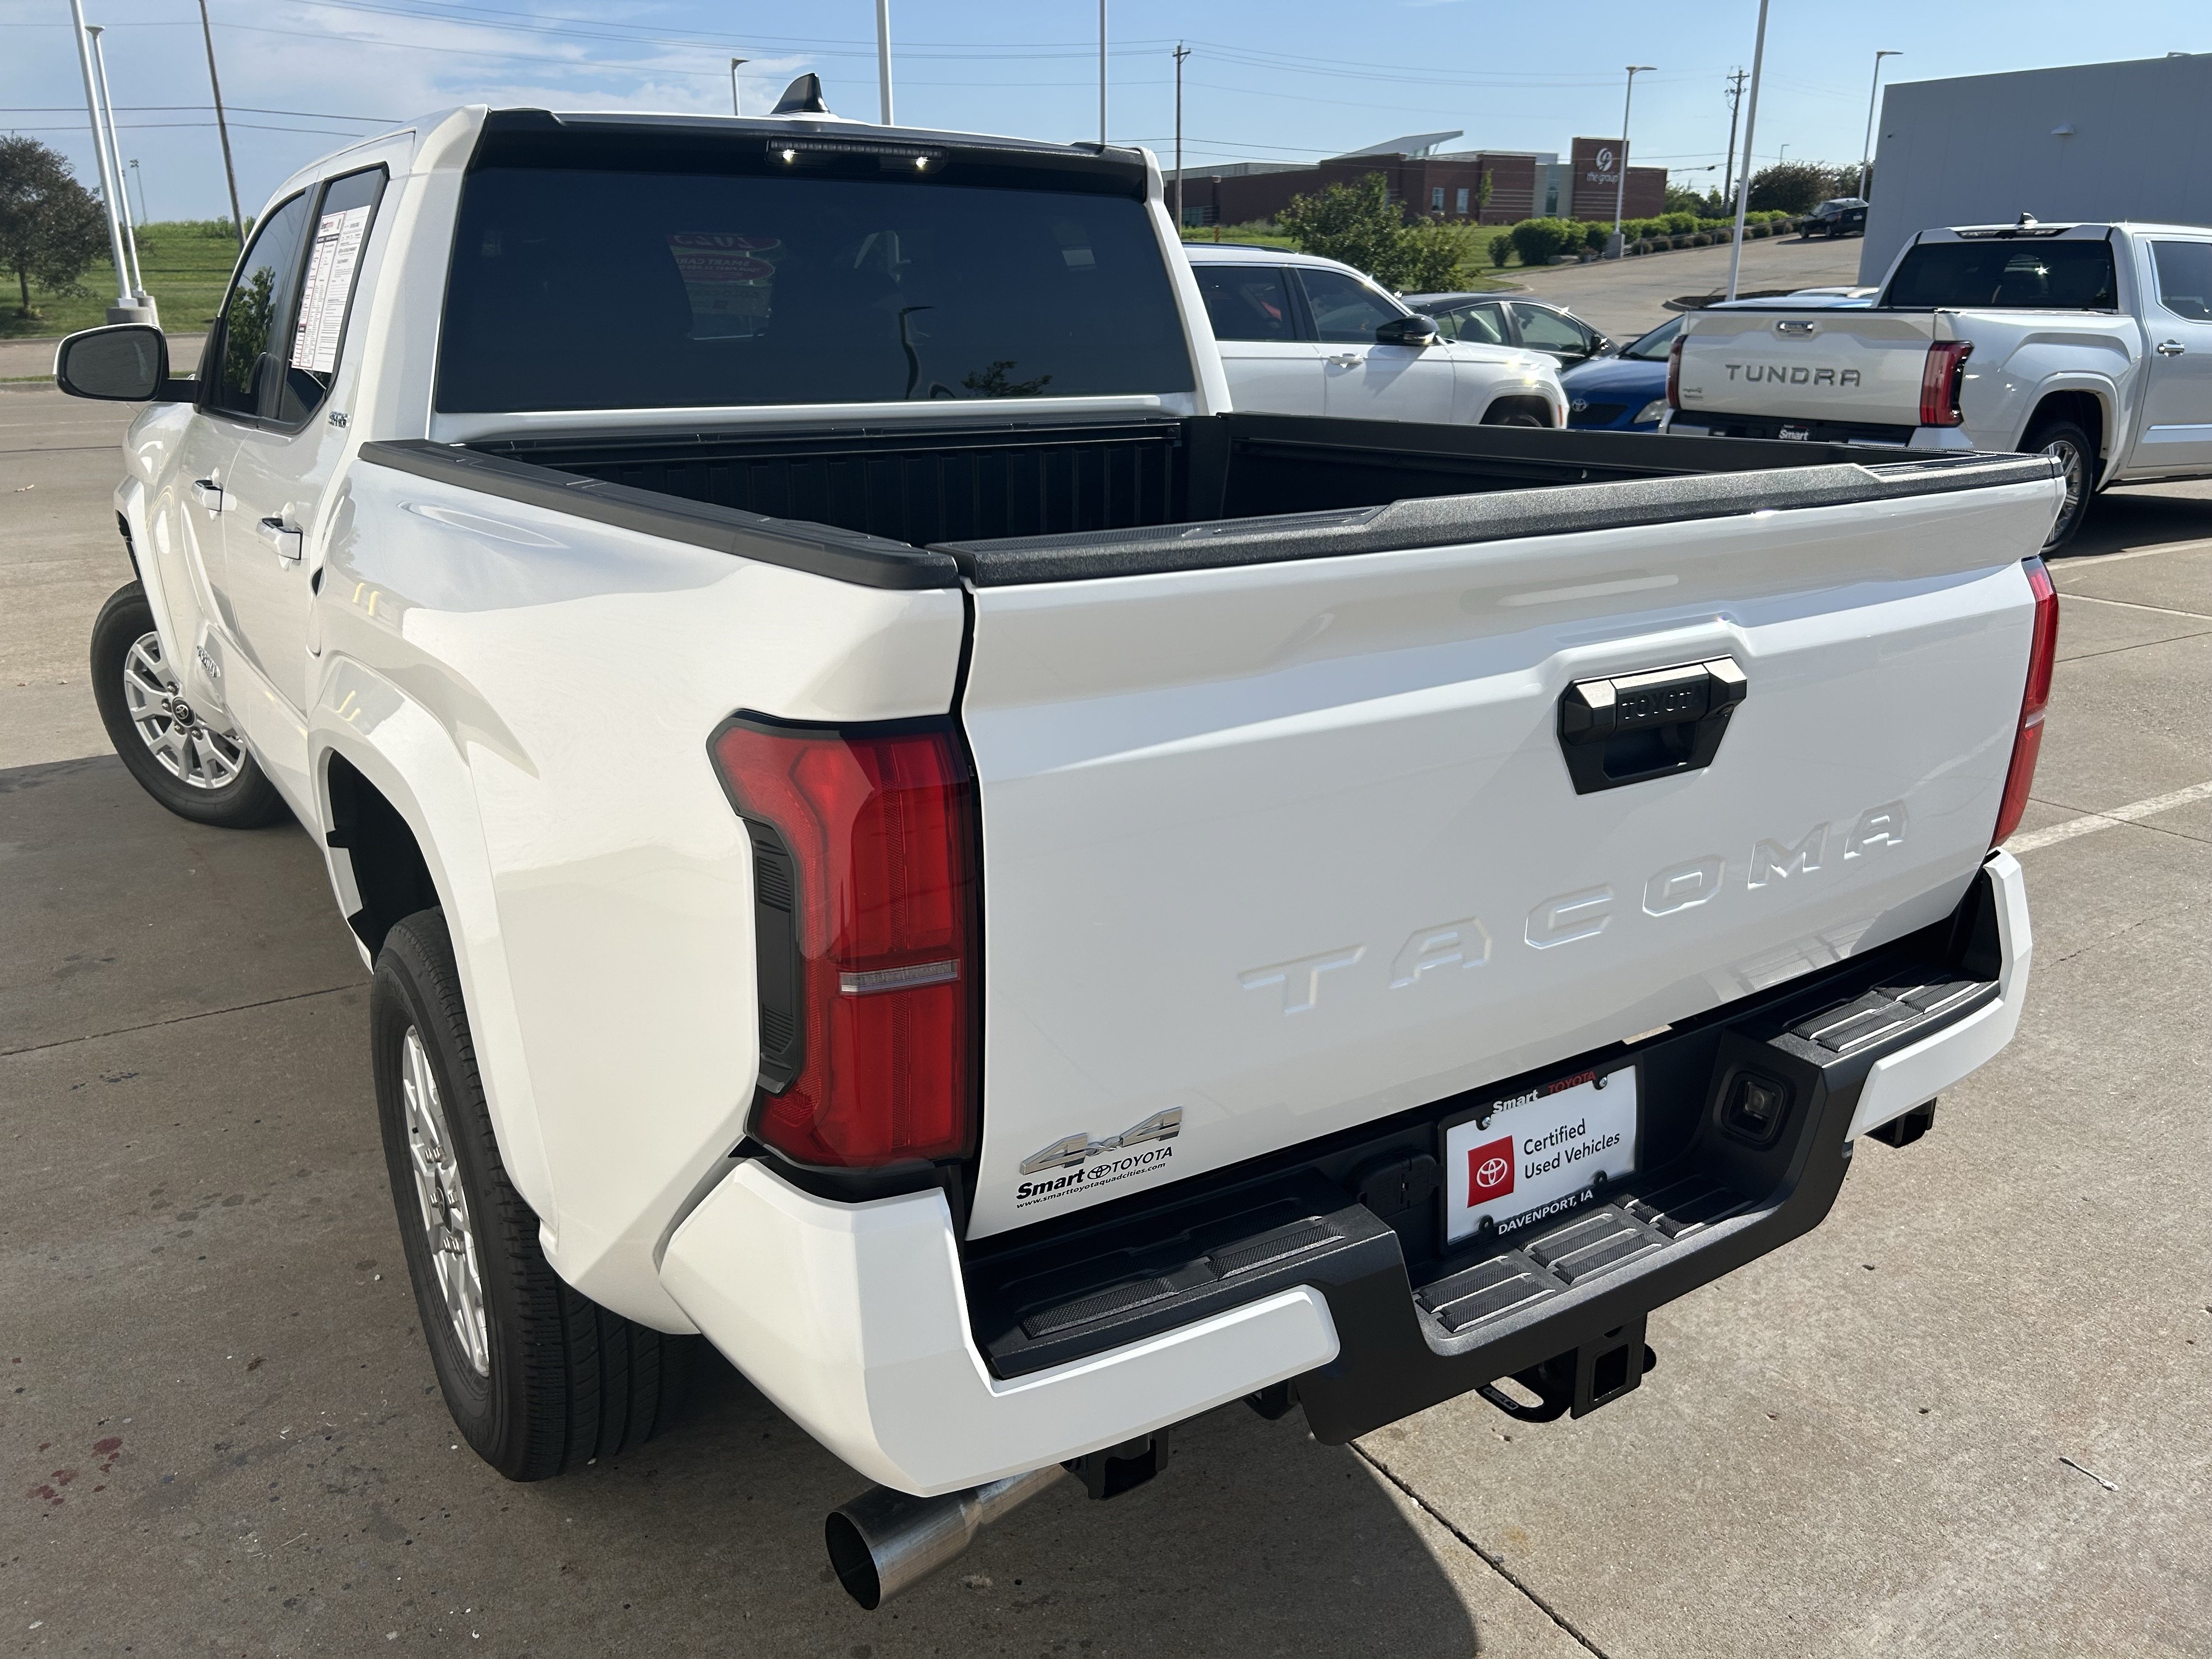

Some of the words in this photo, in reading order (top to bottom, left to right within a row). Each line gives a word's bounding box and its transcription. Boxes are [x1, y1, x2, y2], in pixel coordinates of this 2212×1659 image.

[1725, 364, 1861, 388] TUNDRA
[1779, 428, 1810, 441] Smart
[1237, 798, 1910, 1018] TACOMA
[1492, 1089, 1539, 1114] Smart
[1547, 1070, 1597, 1094] TOYOTA
[1523, 1118, 1587, 1155] Certified
[1525, 1152, 1561, 1179] Used
[1564, 1132, 1621, 1164] Vehicles
[1015, 1168, 1086, 1200] Smart
[1111, 1146, 1173, 1173] TOYOTA
[1016, 1161, 1166, 1209] www.smarttoyotaquadcities.com
[1498, 1195, 1577, 1235] DAVENPORT,
[1580, 1189, 1594, 1201] IA
